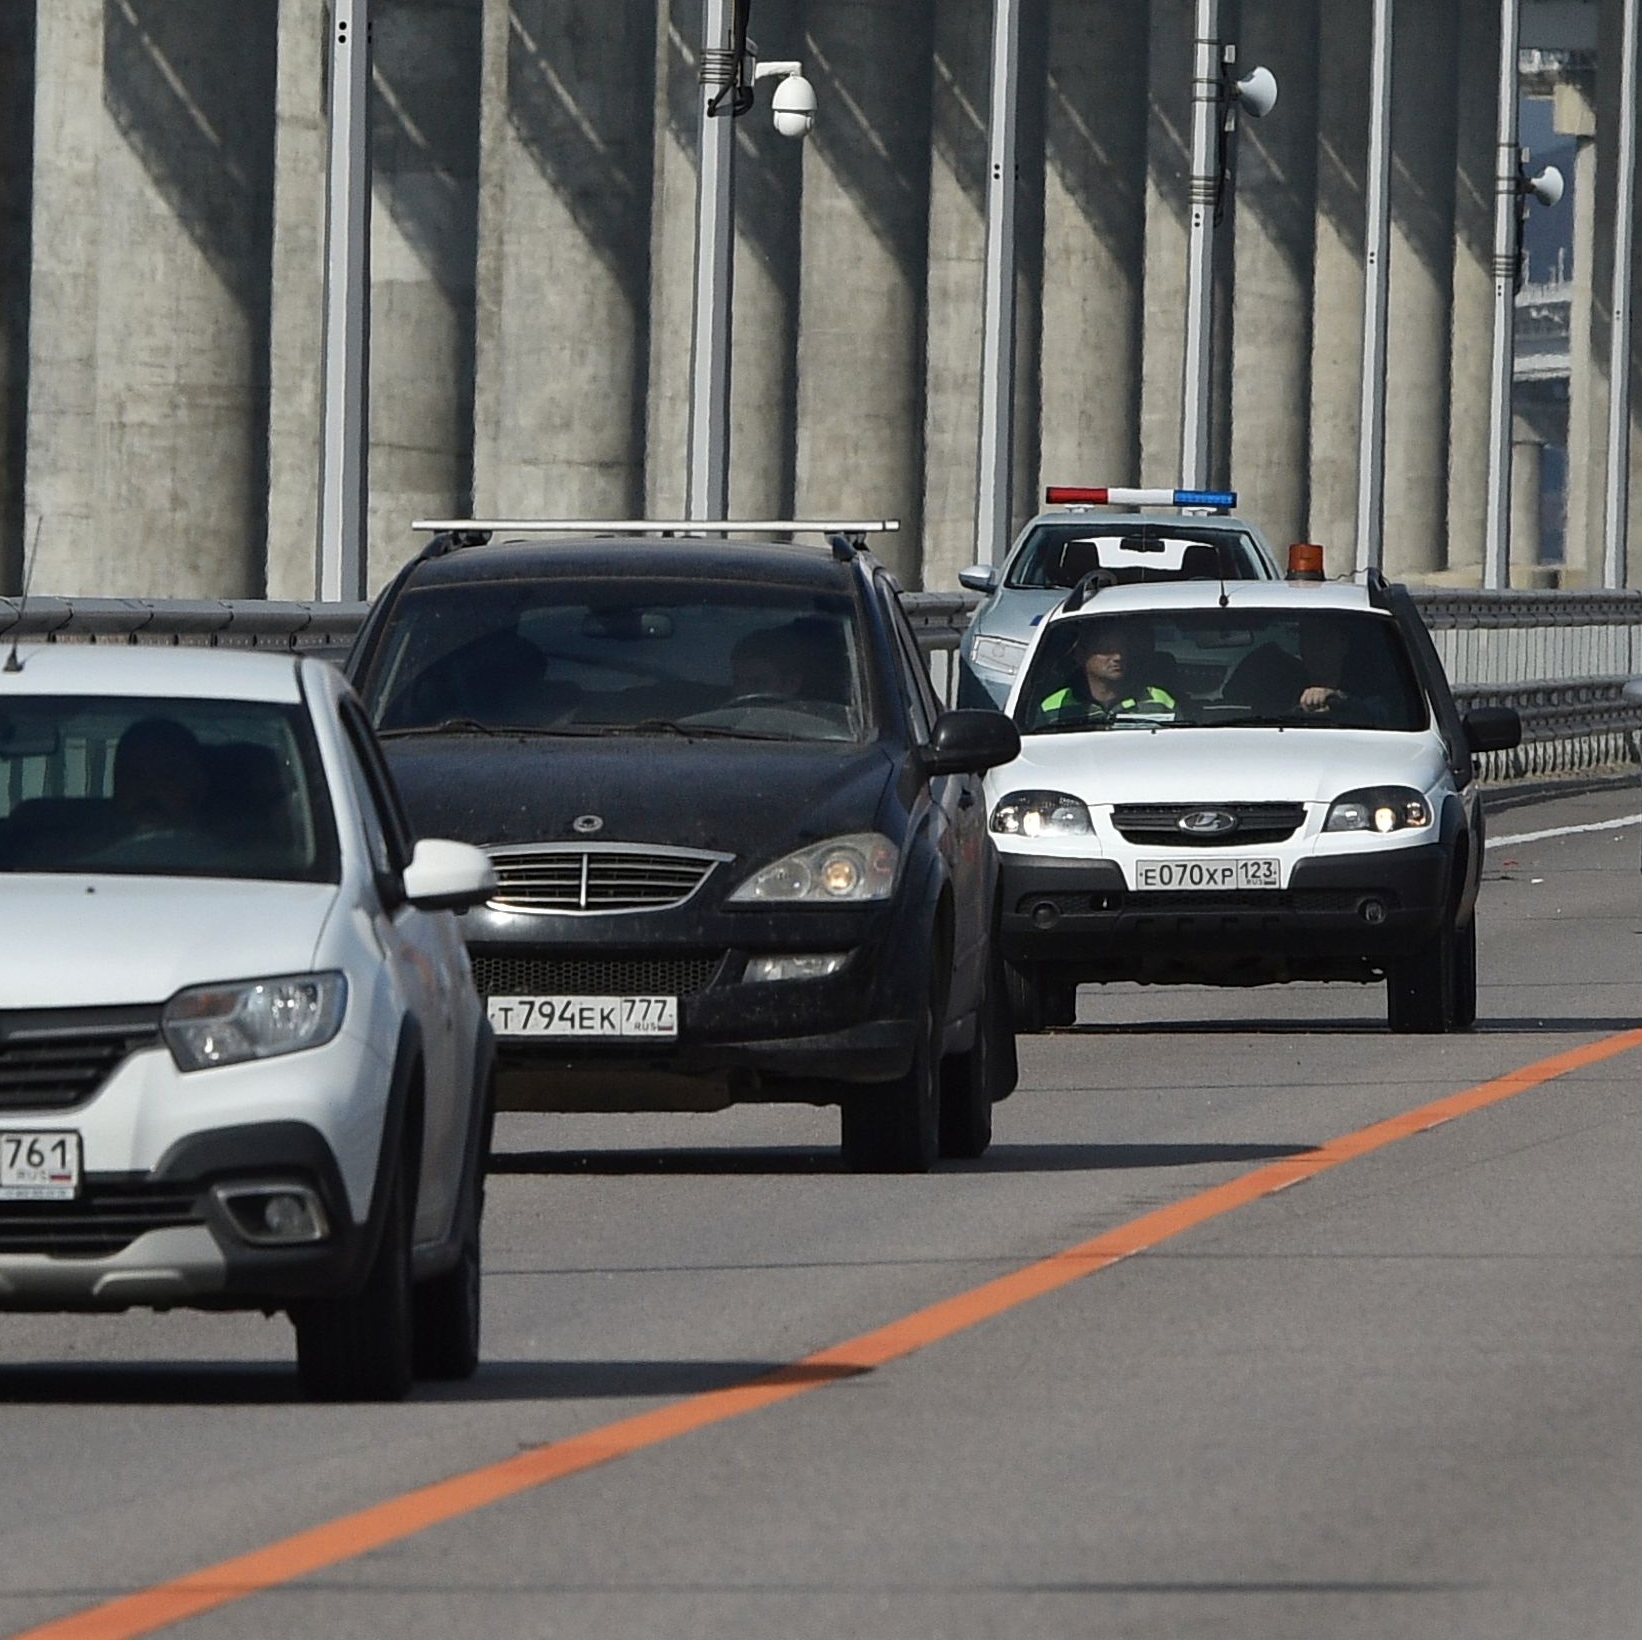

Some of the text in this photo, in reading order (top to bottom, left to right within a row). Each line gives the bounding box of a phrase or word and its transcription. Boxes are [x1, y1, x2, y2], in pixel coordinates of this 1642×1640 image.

[1144, 861, 1273, 886] Е070ХР 123
[498, 999, 667, 1030] Т794ЕК 777
[634, 1022, 657, 1031] RUS
[5, 1138, 68, 1169] 761
